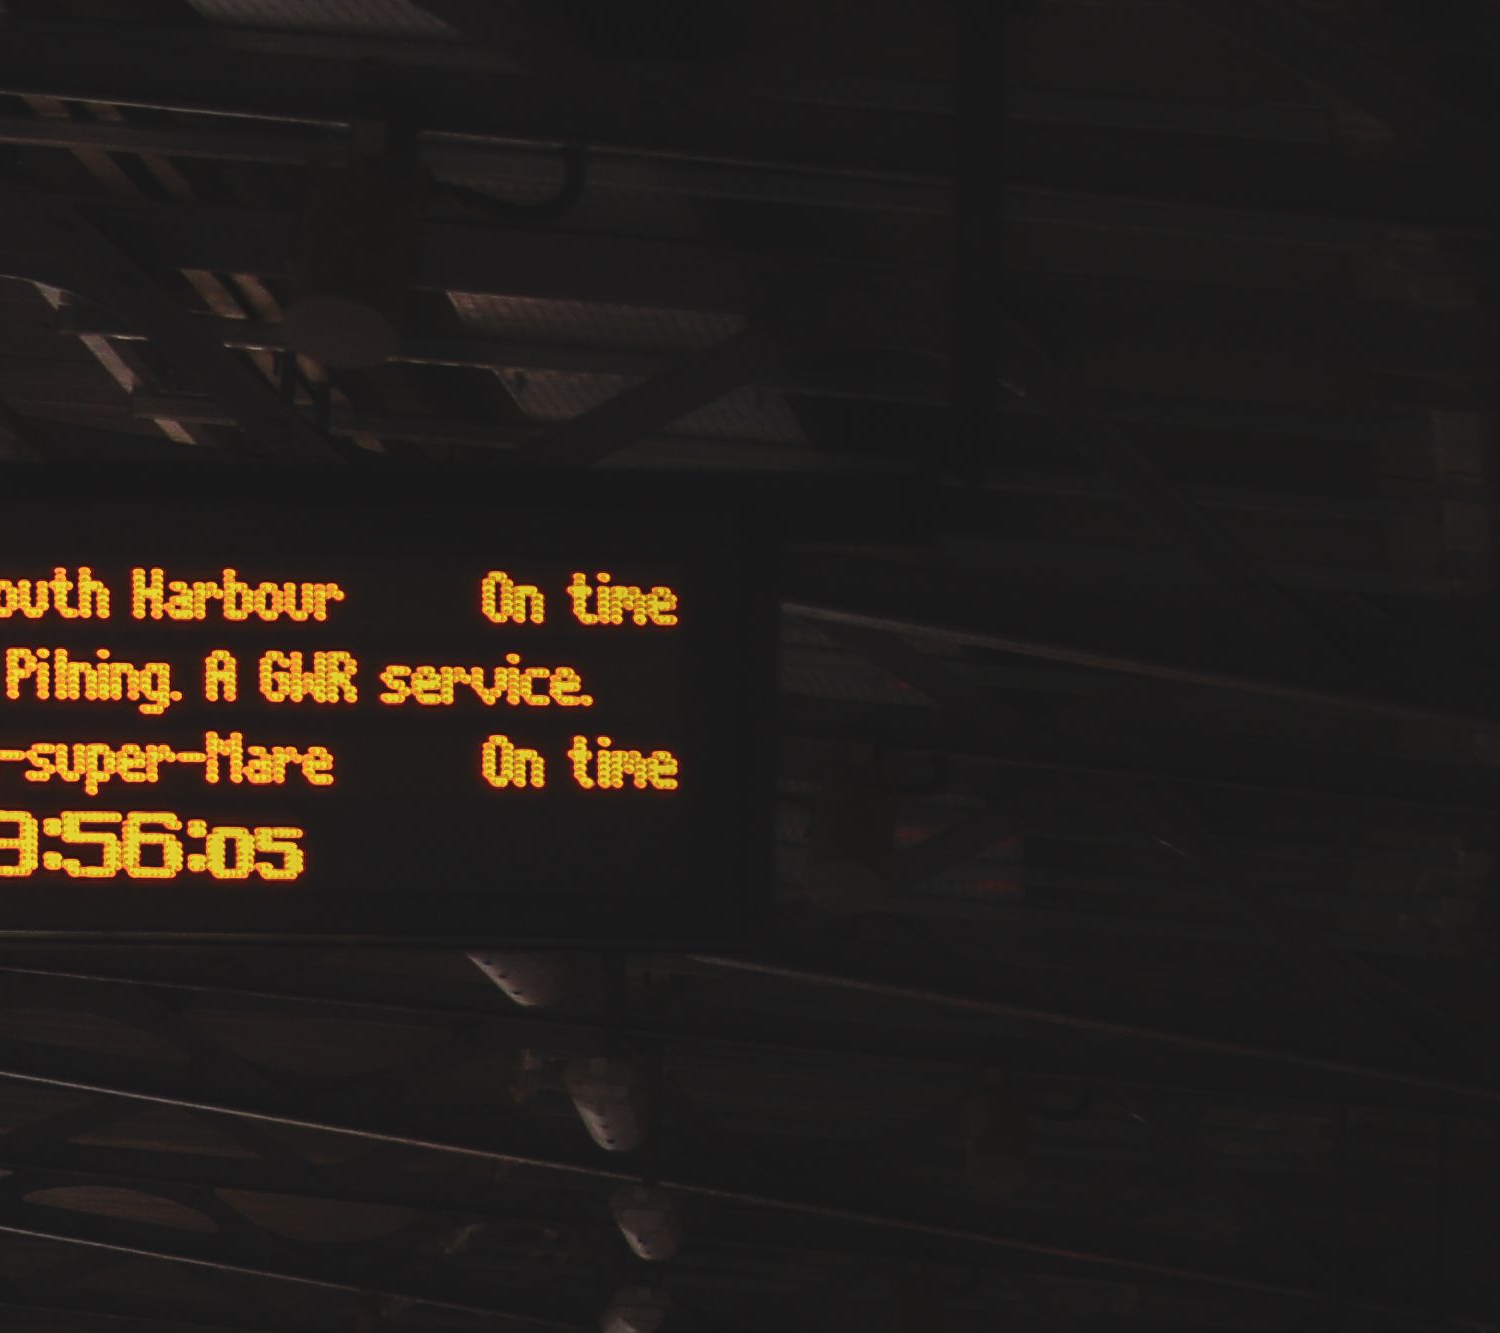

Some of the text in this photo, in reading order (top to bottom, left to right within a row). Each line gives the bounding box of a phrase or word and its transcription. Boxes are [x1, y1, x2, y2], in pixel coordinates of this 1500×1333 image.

[130, 567, 346, 622] Harbour
[481, 570, 546, 625] On
[566, 572, 679, 627] time
[204, 649, 238, 703] A
[258, 649, 359, 704] GWR
[379, 652, 594, 707] service.
[481, 734, 546, 789] On
[566, 734, 679, 791] time
